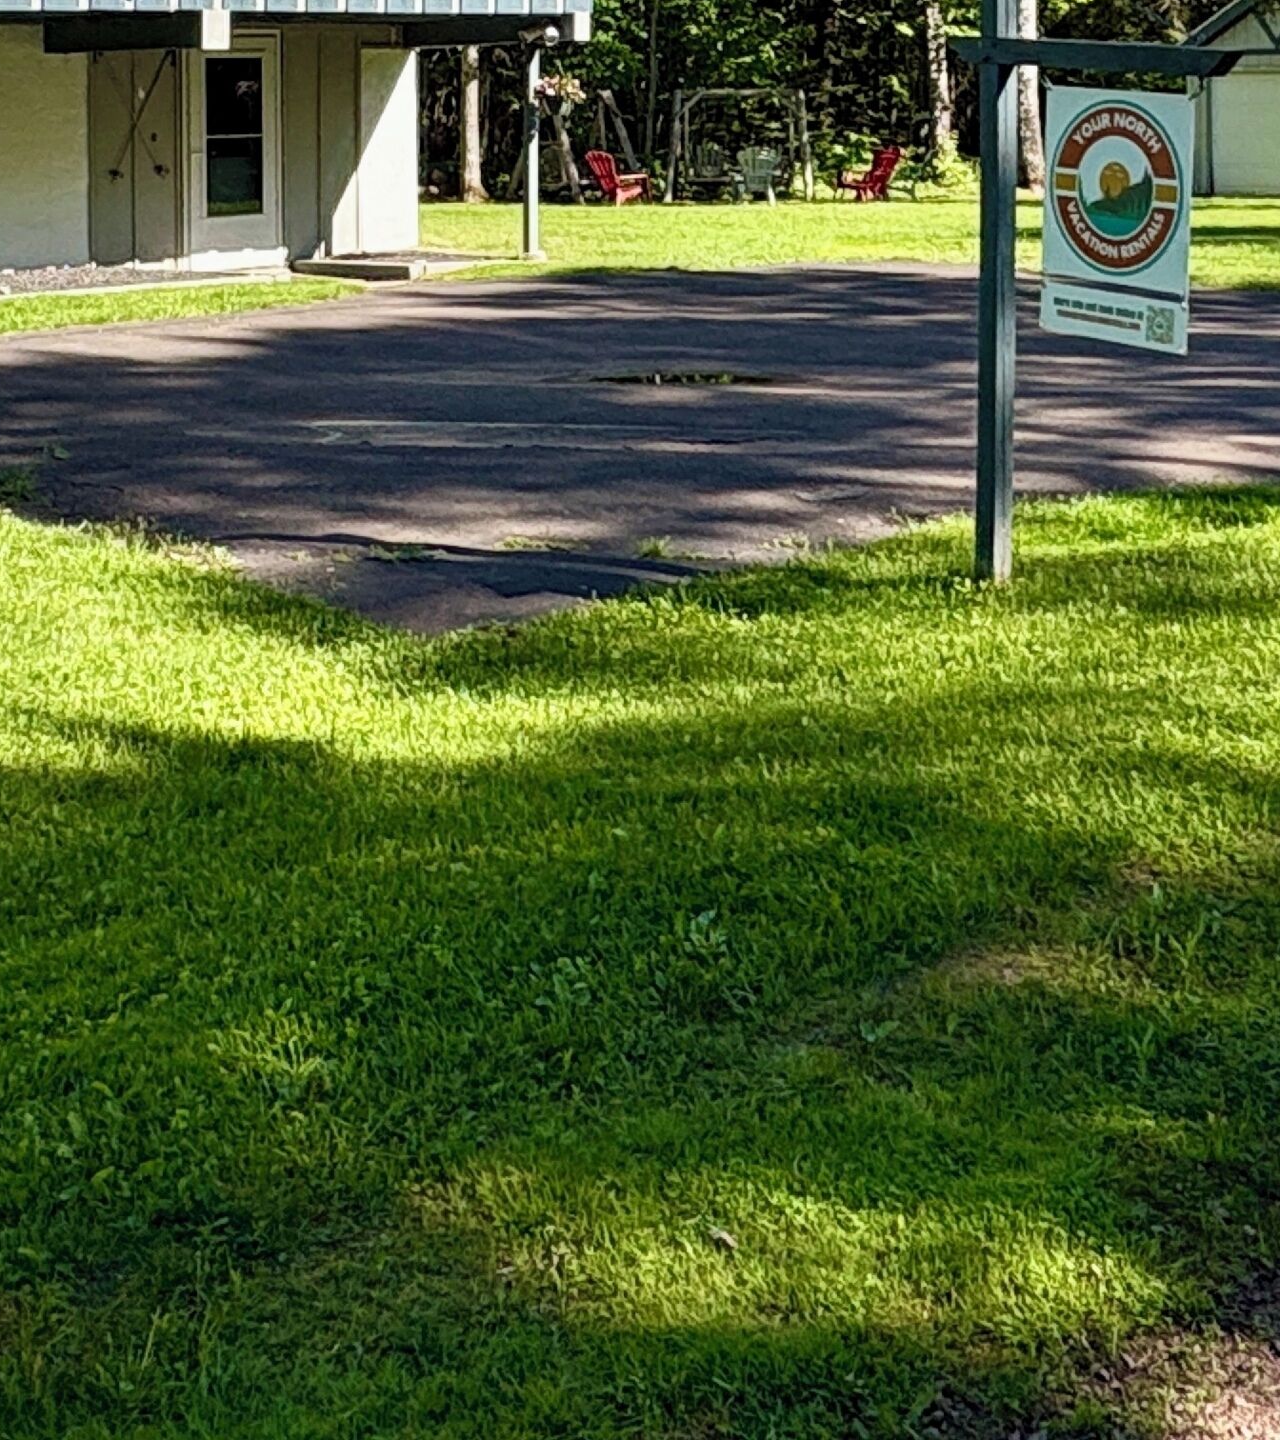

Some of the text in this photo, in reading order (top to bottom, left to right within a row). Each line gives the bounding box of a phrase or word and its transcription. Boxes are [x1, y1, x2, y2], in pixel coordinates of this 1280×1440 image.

[1072, 112, 1162, 154] YOUR NORTH
[1066, 201, 1166, 259] VACATION RENTALS
